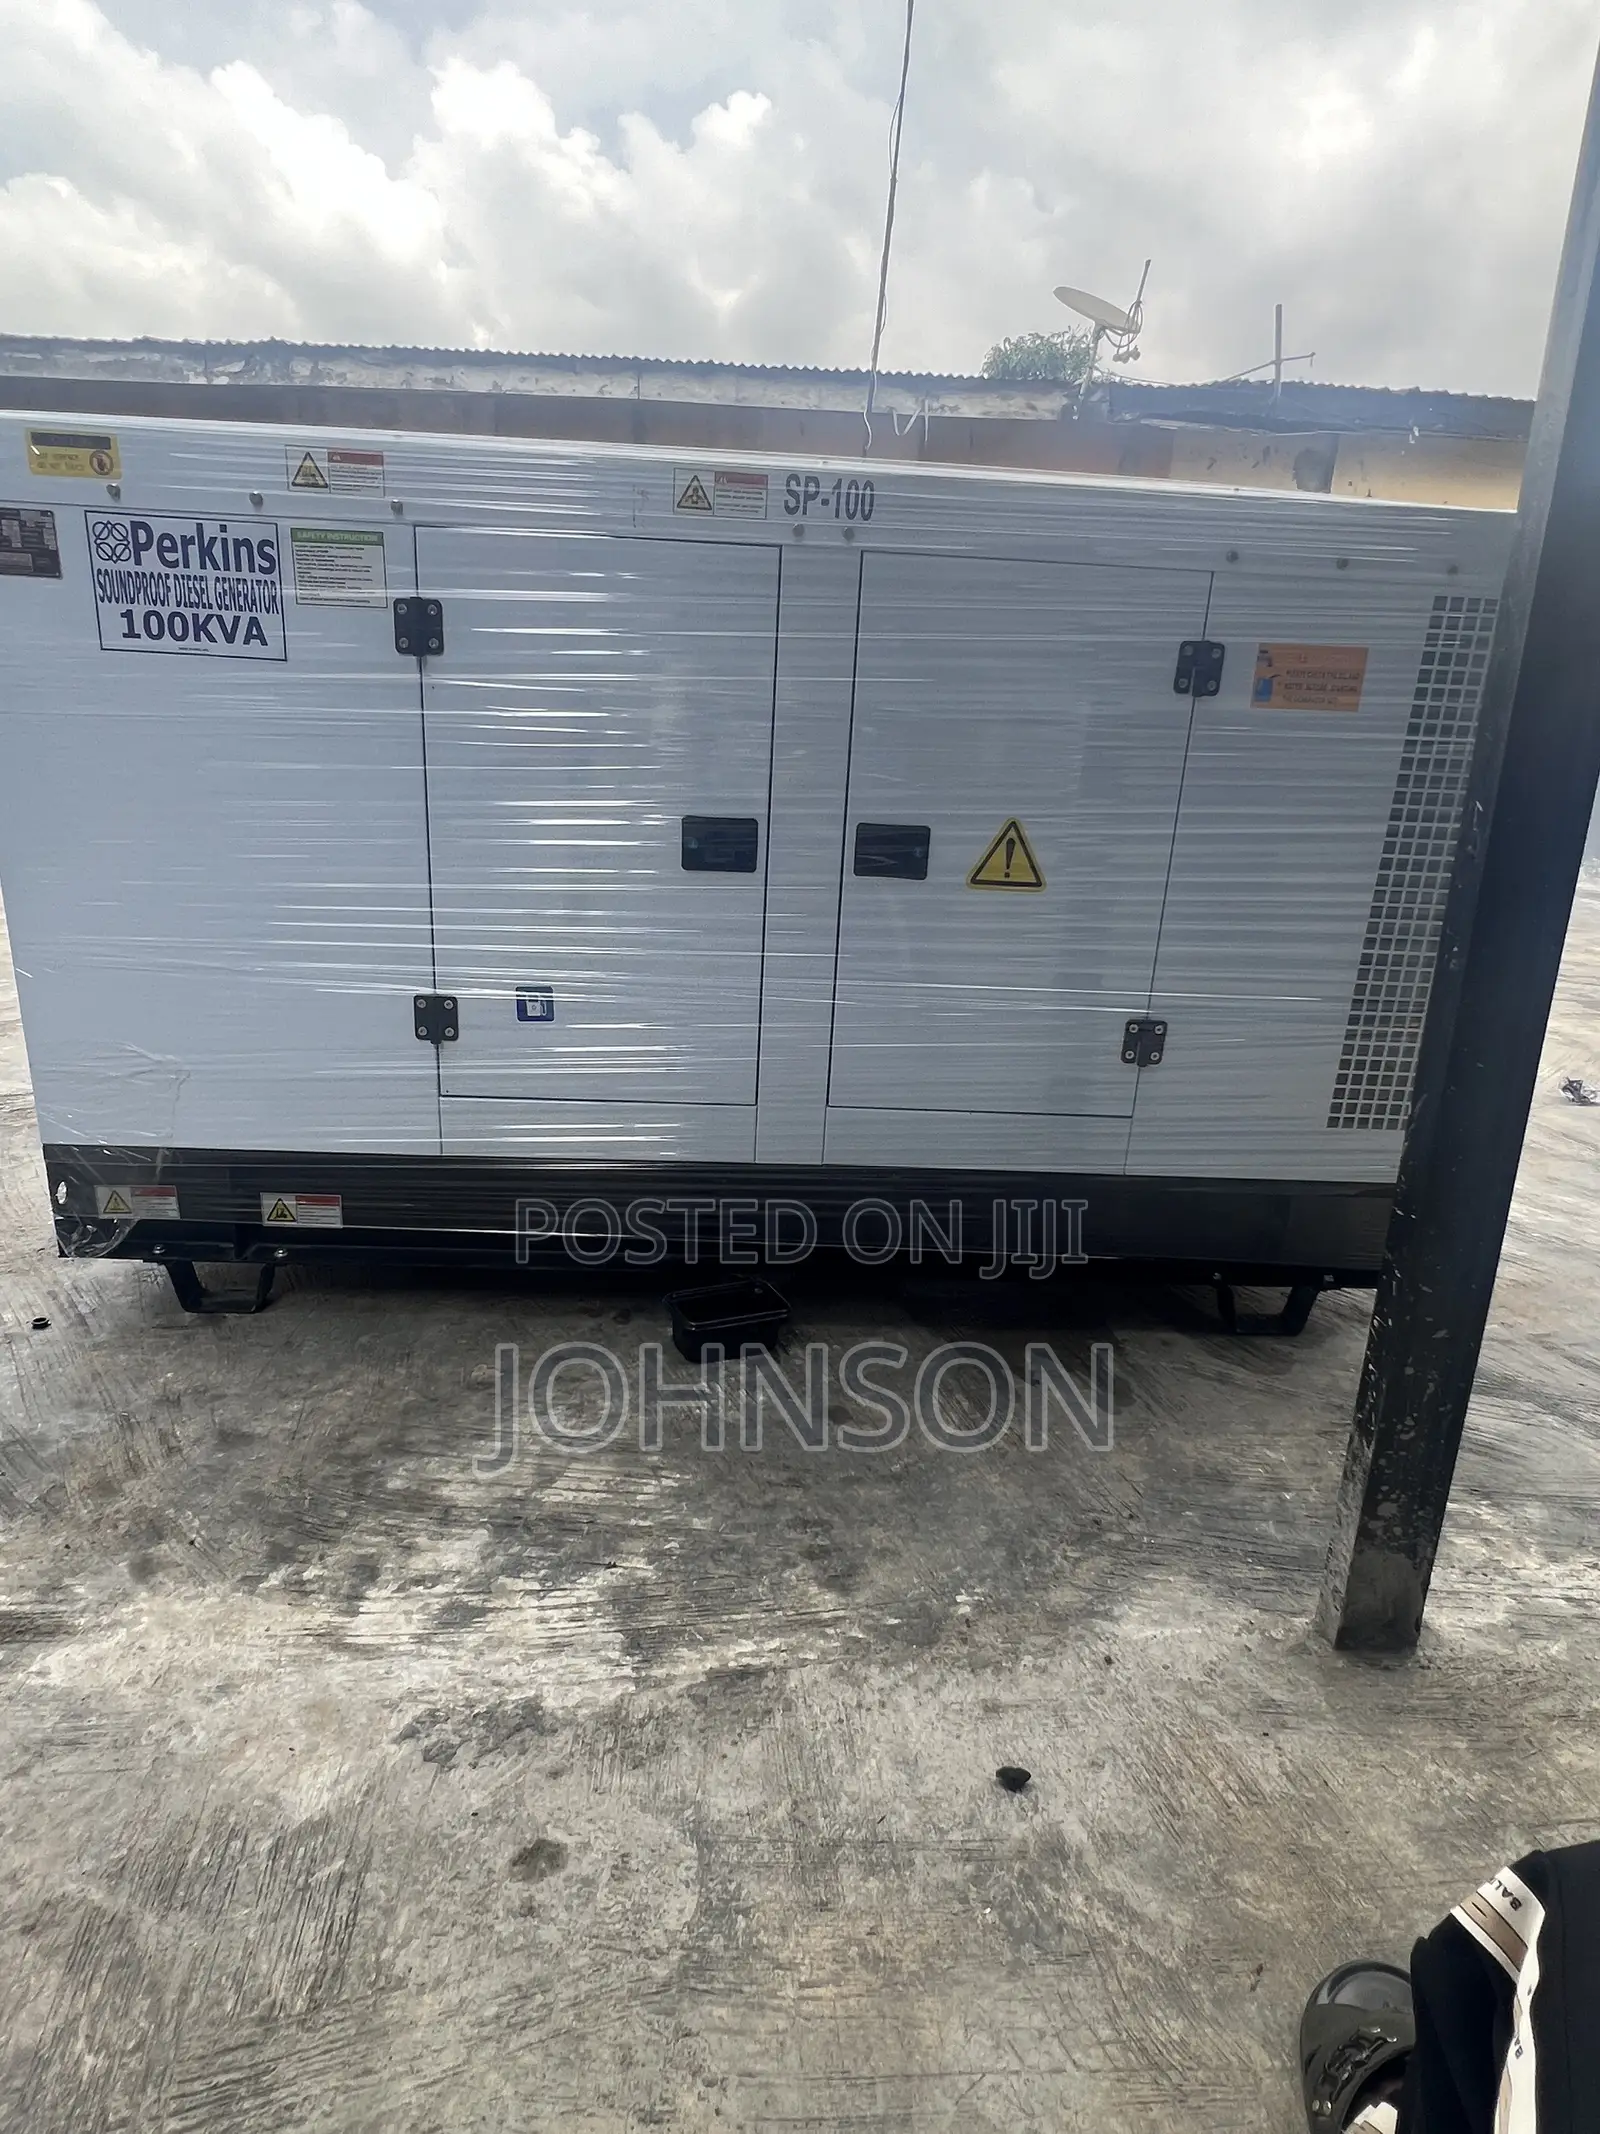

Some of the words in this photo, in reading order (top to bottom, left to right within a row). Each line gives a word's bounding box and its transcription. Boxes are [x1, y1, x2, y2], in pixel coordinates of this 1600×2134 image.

[784, 474, 875, 521] SP-100
[129, 520, 277, 575] Perkins
[96, 568, 171, 607] SOUNDPROOF
[173, 574, 213, 611] DIESEL
[214, 576, 280, 615] GENERATOR
[120, 608, 269, 647] 100KVA
